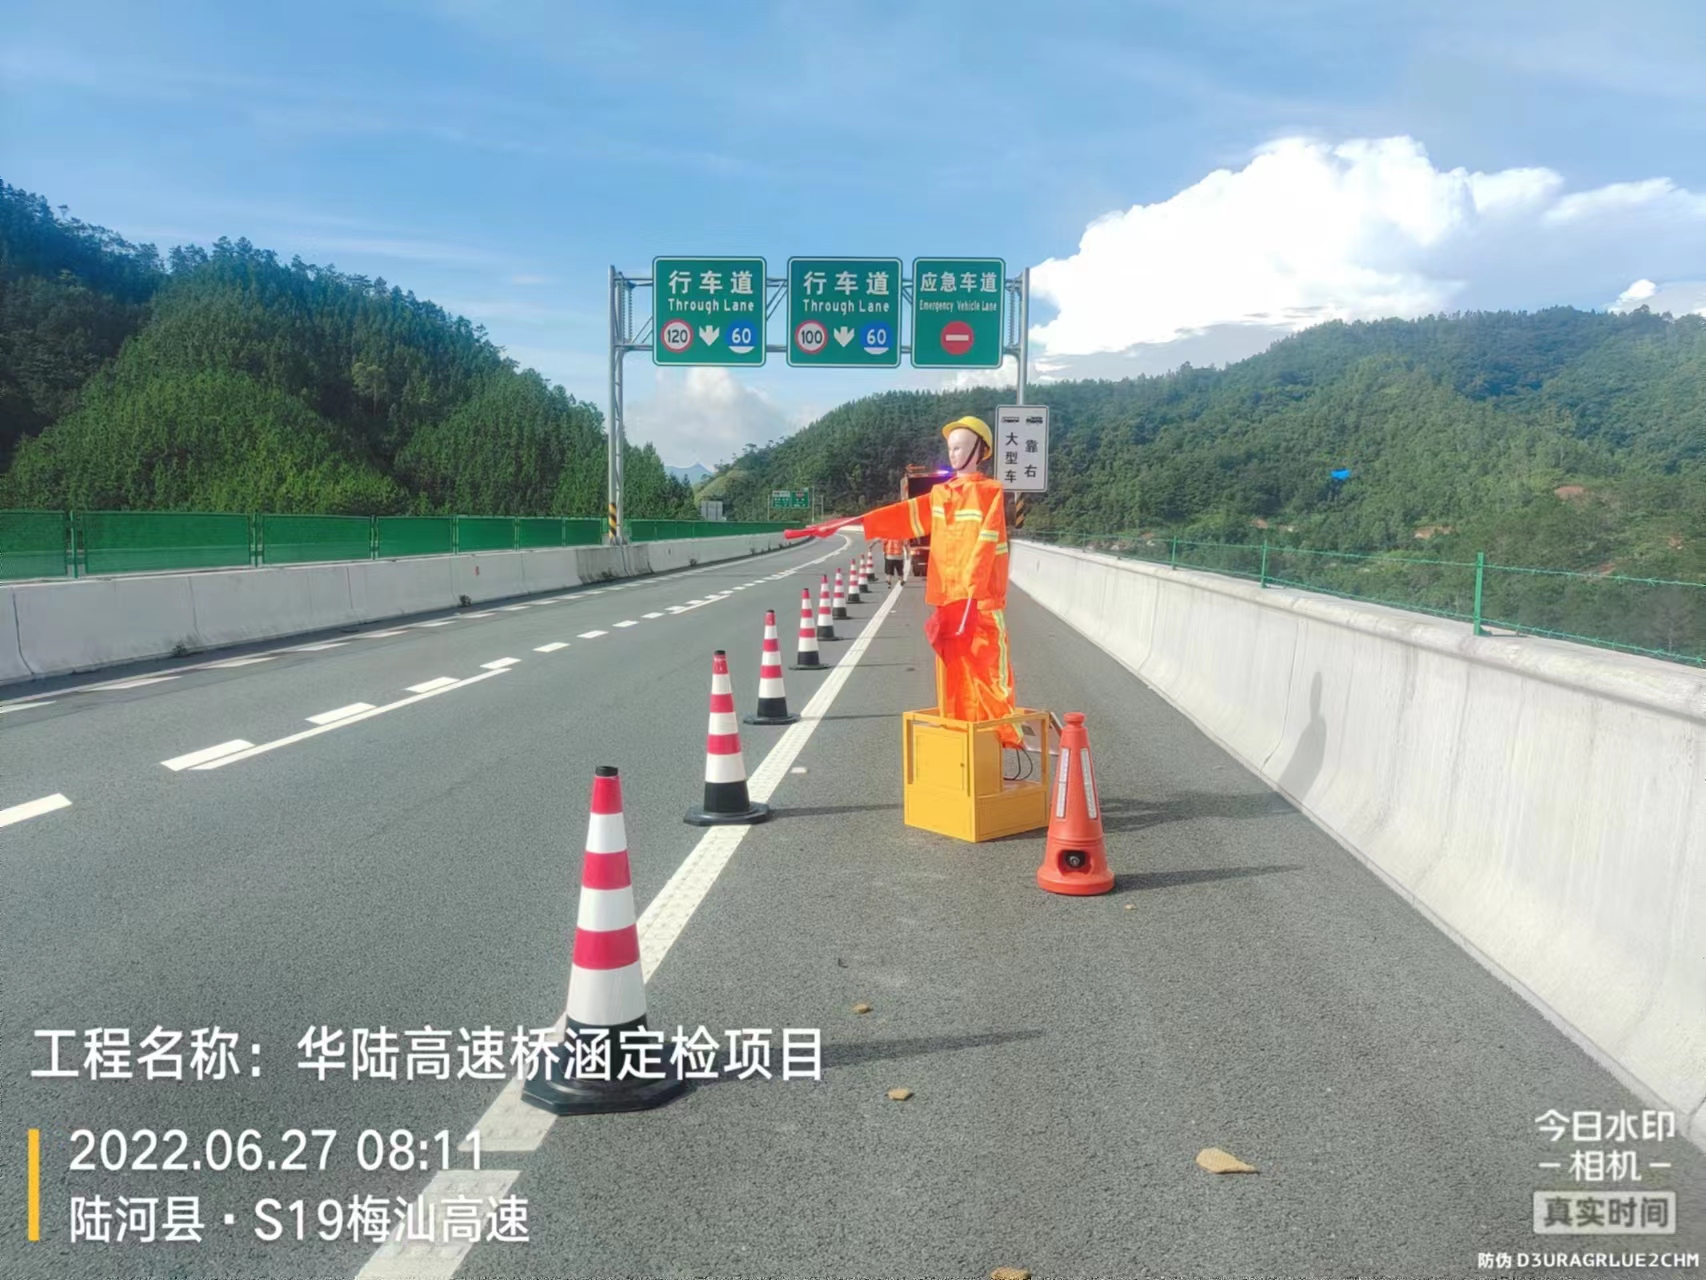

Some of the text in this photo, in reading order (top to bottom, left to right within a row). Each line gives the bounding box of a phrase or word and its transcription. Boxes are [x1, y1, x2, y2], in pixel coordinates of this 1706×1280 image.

[668, 270, 753, 294] 行车道
[803, 270, 889, 295] 行车道
[920, 271, 997, 293] 应急车道
[668, 298, 754, 315] Through Lane
[803, 299, 890, 316] Through Lane
[920, 299, 997, 312] Emergency Vehicle Lane
[667, 329, 688, 343] 120
[731, 328, 752, 343] 60
[801, 330, 823, 344] 100
[866, 329, 887, 345] 60
[1004, 432, 1018, 483] 大型车
[1024, 439, 1038, 478] 靠右
